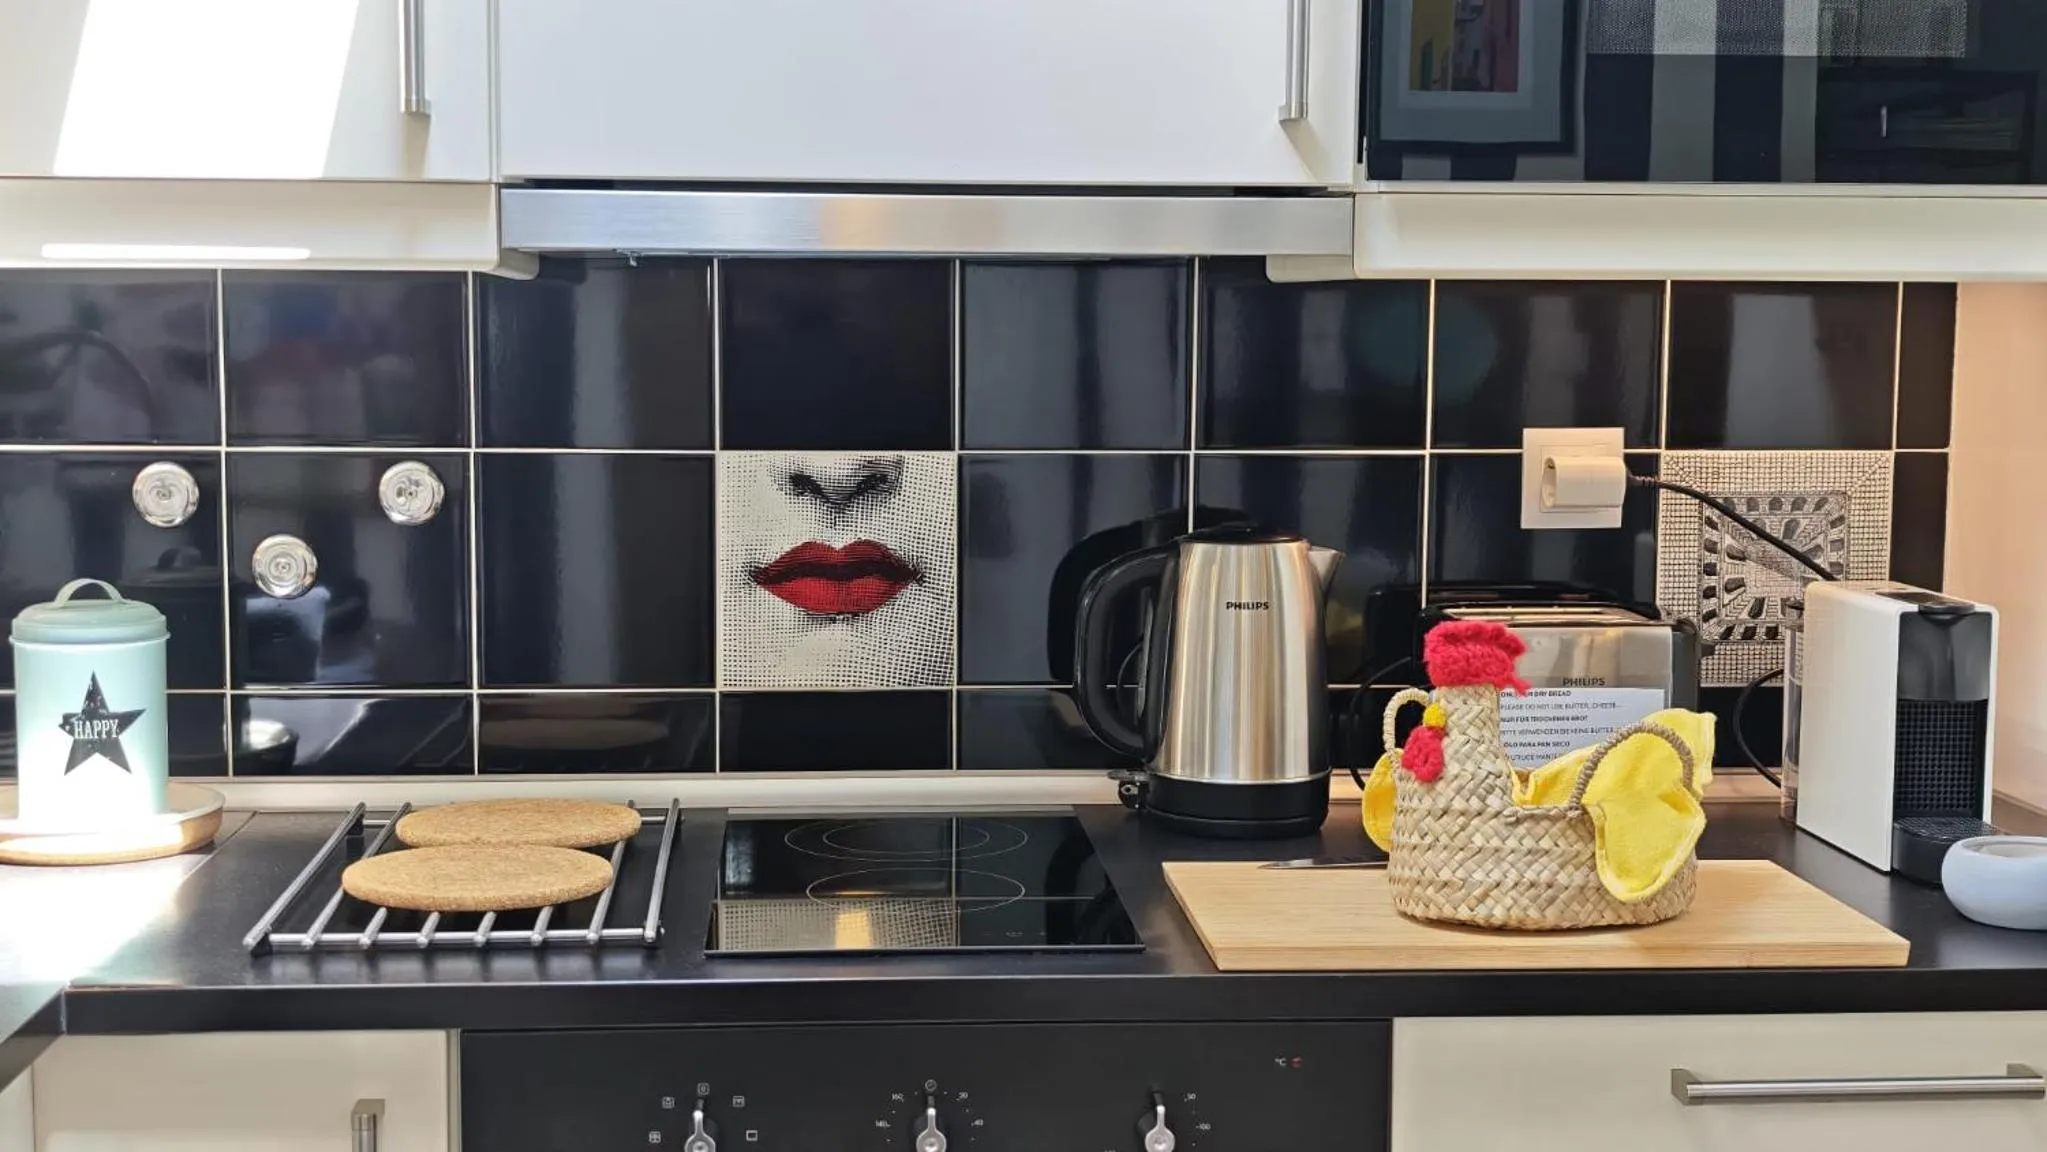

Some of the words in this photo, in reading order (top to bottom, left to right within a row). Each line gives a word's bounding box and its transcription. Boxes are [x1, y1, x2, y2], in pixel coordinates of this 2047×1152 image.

[1226, 601, 1270, 610] PHILIPS
[1562, 677, 1606, 687] PHILIPS
[74, 719, 120, 739] HAPPY
